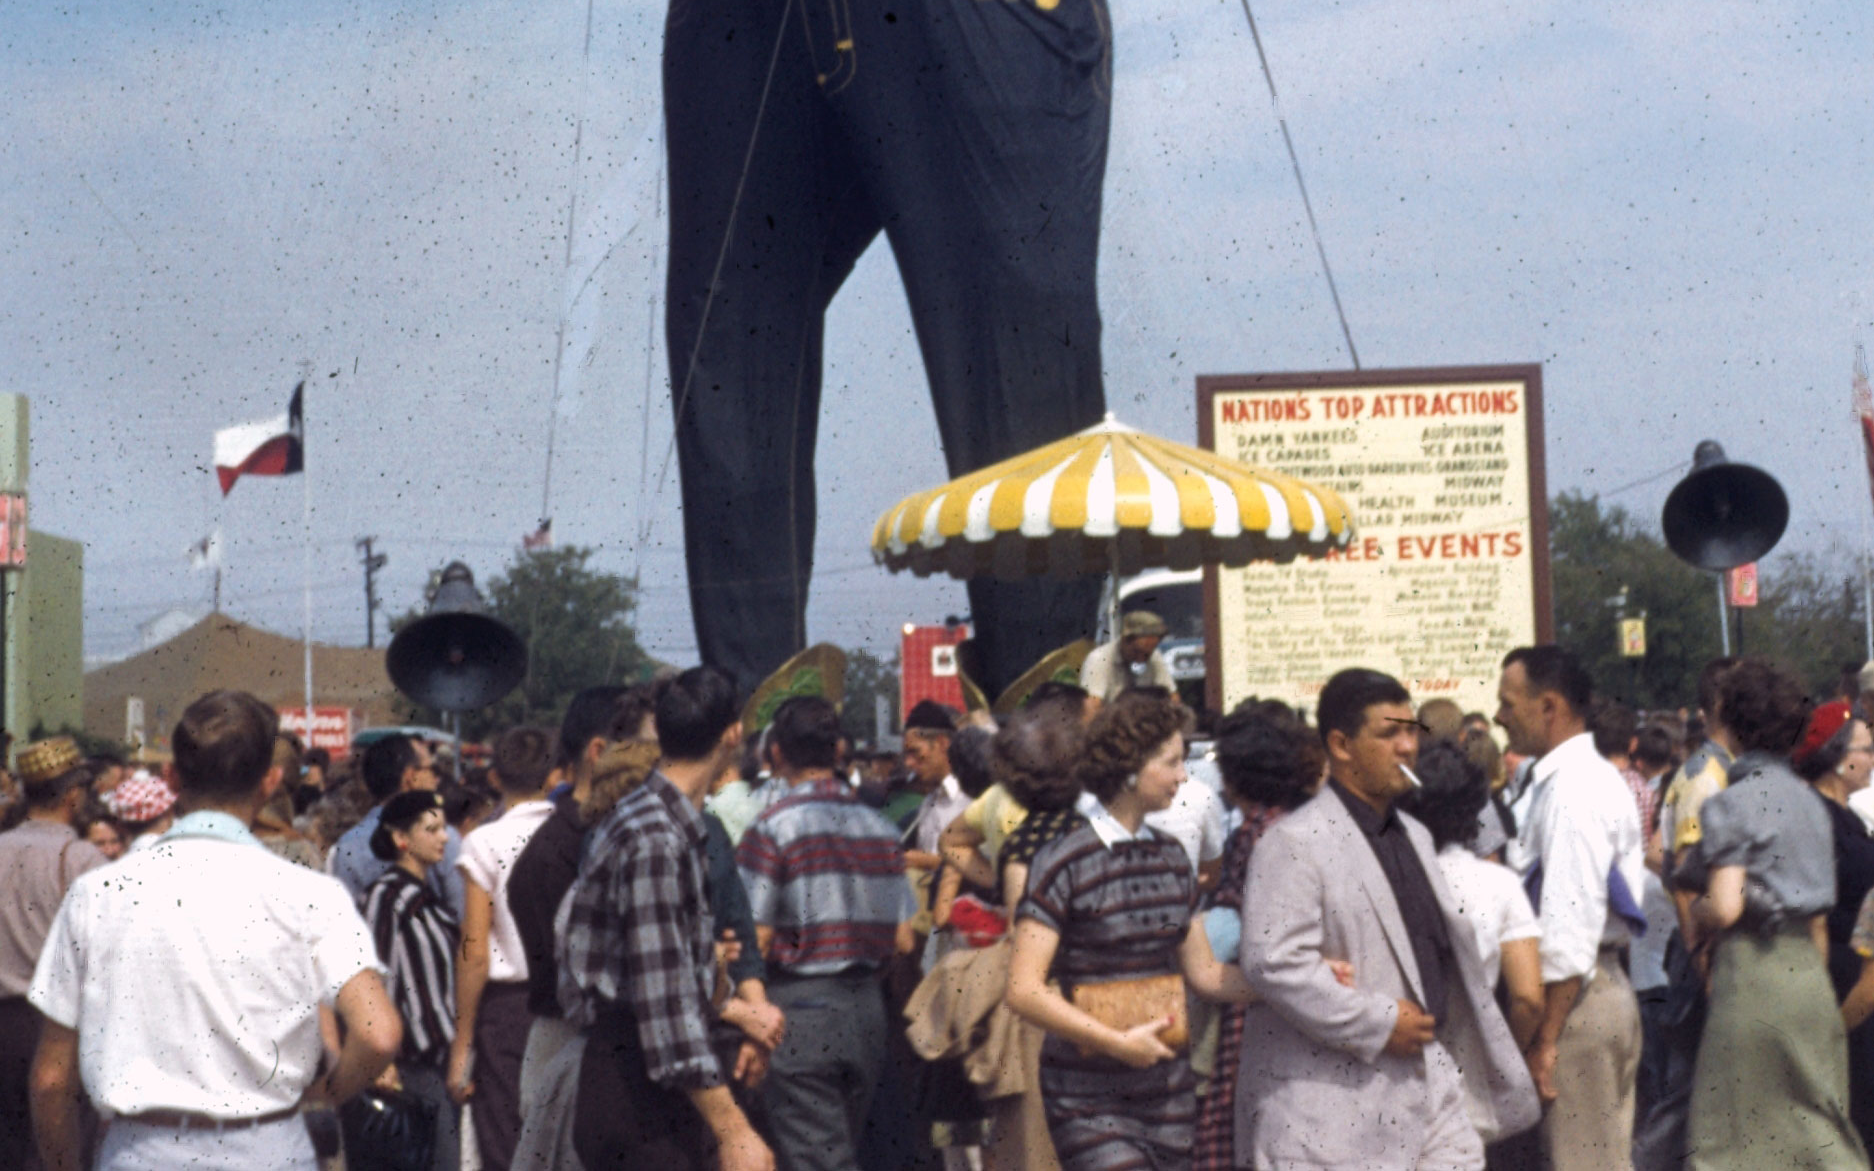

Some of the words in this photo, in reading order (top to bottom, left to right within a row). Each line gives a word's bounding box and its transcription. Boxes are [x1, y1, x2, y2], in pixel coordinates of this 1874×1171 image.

[1320, 395, 1365, 420] TOP
[1371, 389, 1519, 418] ATTRACTIONS
[1237, 433, 1285, 447] DAMN
[1293, 428, 1359, 445] YANKEES
[1421, 424, 1505, 442] AUDITORIUM
[1266, 447, 1331, 463] CAPADES
[1423, 442, 1445, 457] ICE
[1452, 440, 1505, 456] ARENA
[1435, 457, 1510, 474] GRANDSTAND
[1444, 475, 1505, 489] MIDWAY
[1358, 495, 1415, 509] HEALTH
[1434, 492, 1502, 507] MUSEUM
[1401, 511, 1464, 526] MIDWAY
[1308, 536, 1380, 563] REE
[1397, 530, 1523, 561] EVENTS
[1415, 678, 1462, 692] TODAY
